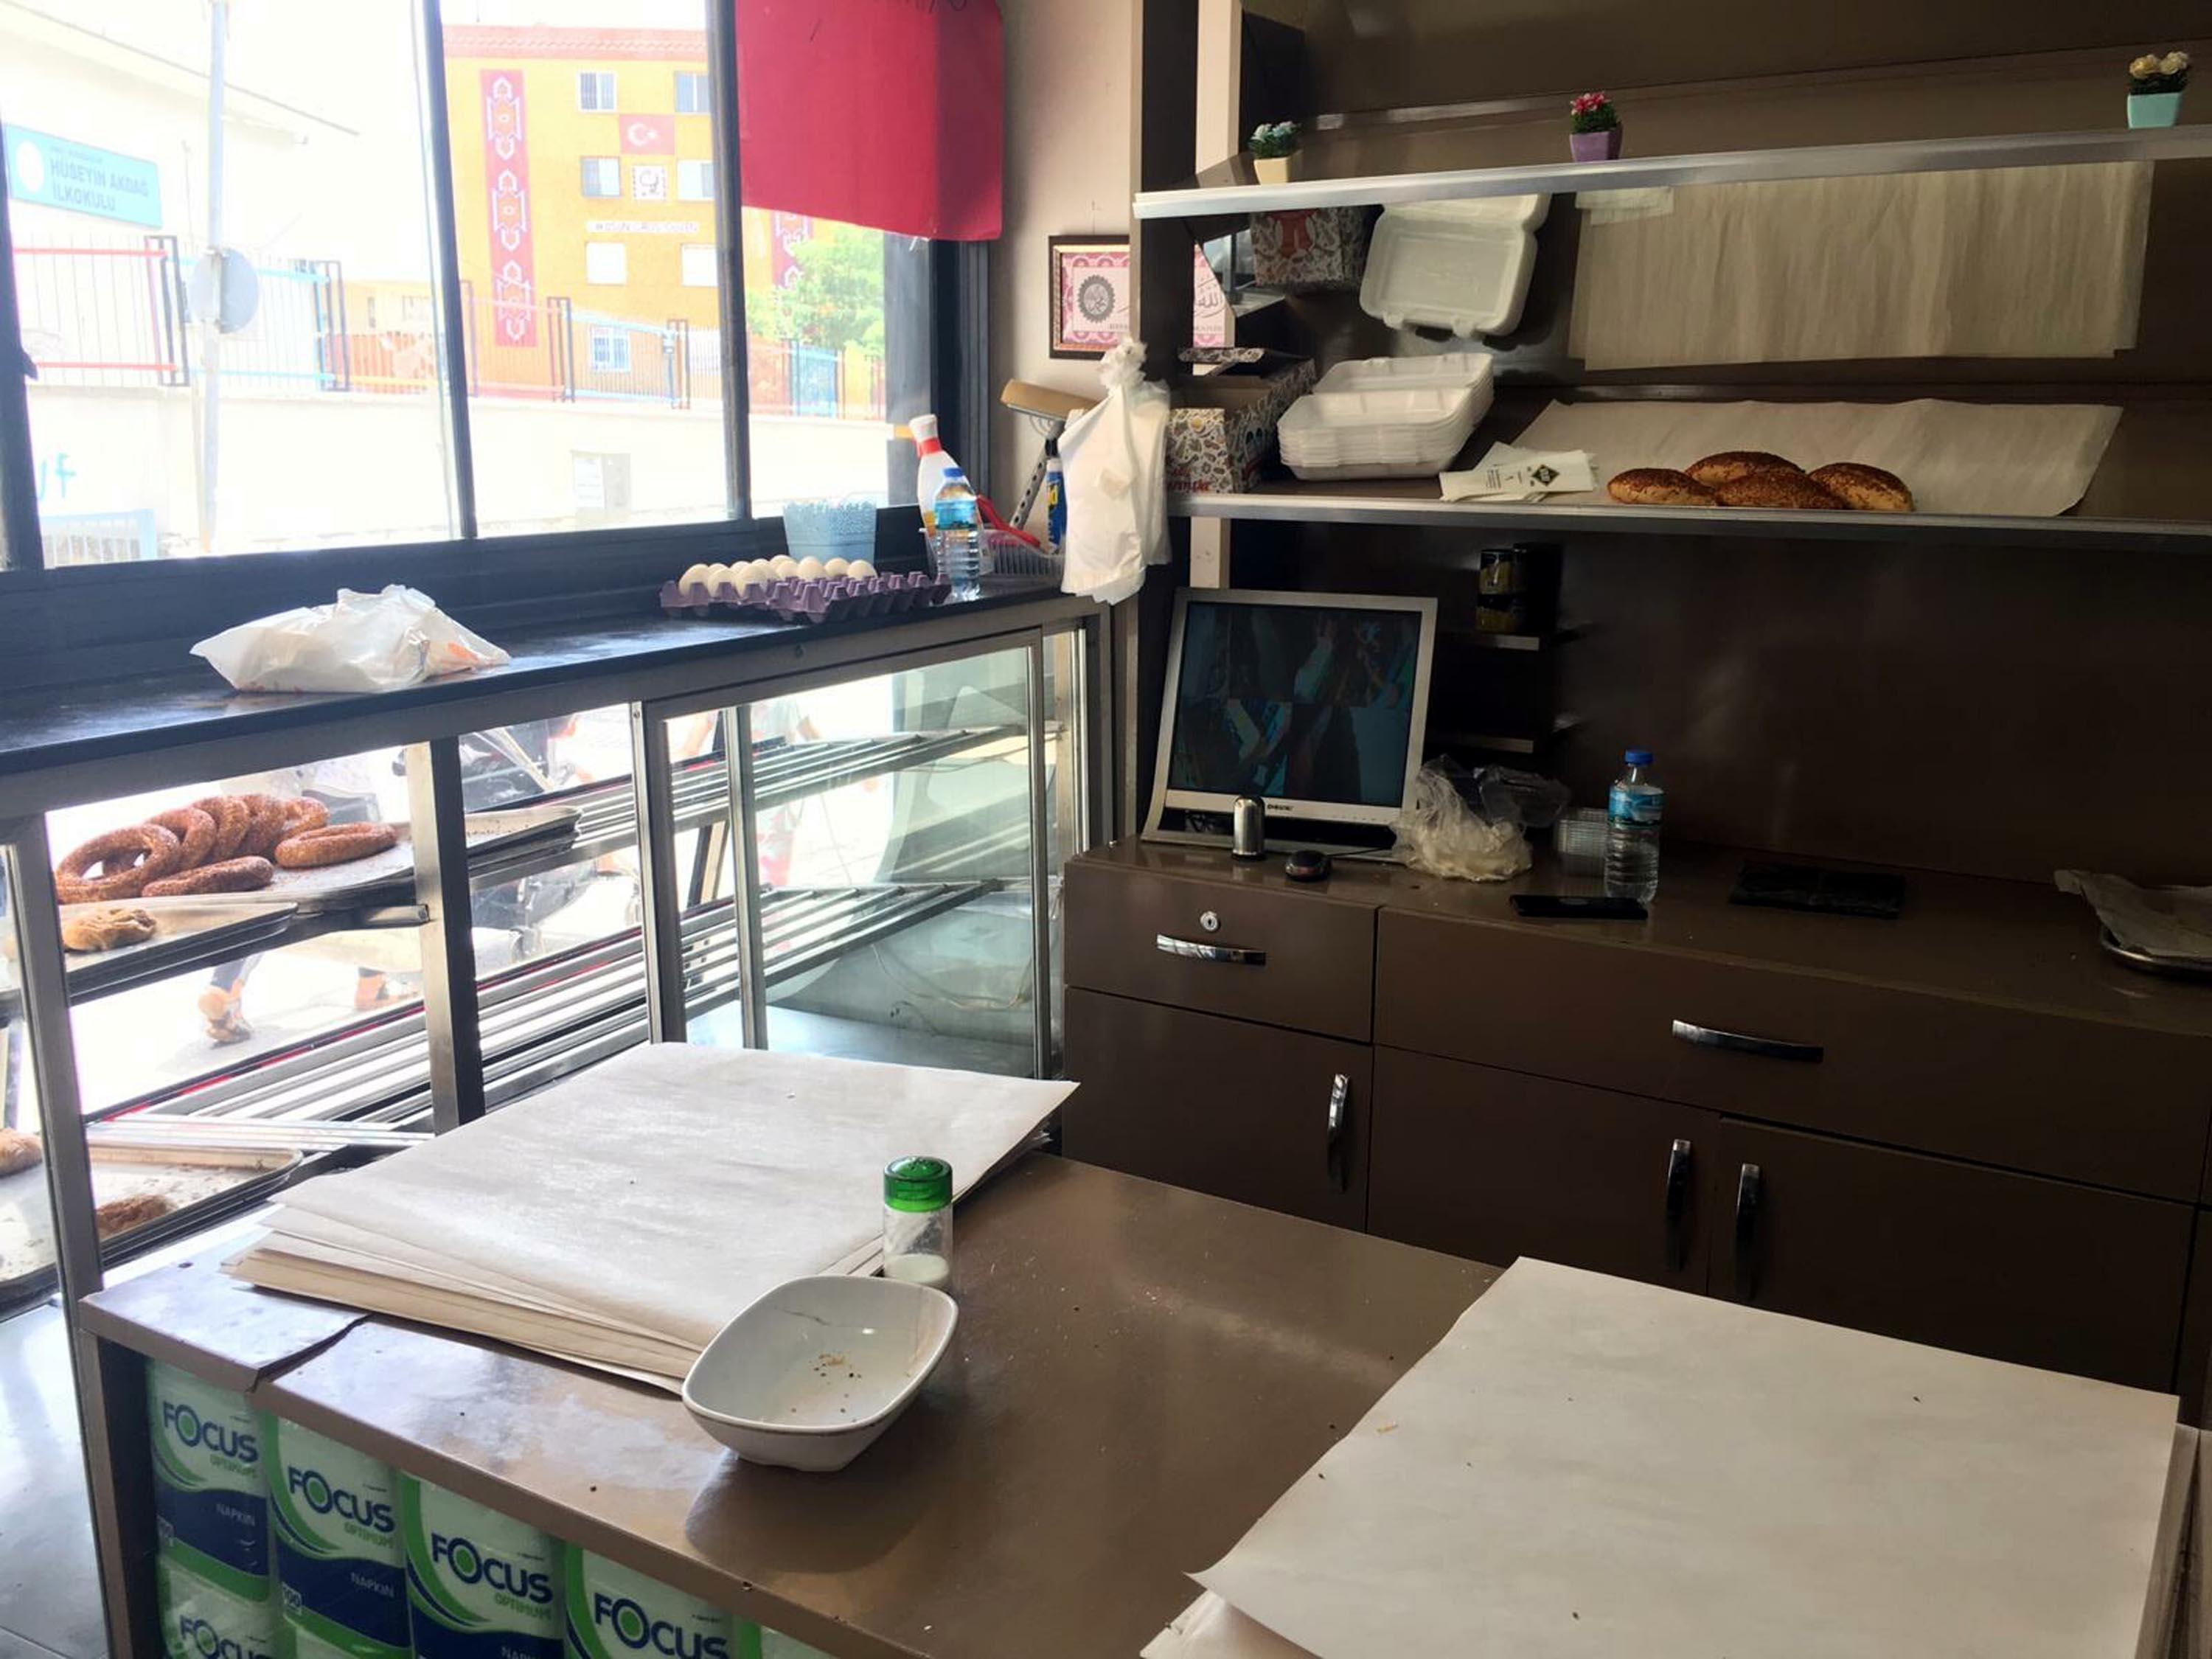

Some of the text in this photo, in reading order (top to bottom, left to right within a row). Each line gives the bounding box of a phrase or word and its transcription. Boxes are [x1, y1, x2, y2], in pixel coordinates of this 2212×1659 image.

[163, 1401, 259, 1463] FOCUS
[288, 1465, 395, 1533] FOCUS
[349, 1571, 395, 1599] NAPKIN
[431, 1532, 553, 1604] FOCUS
[594, 1593, 728, 1659] FOCUS
